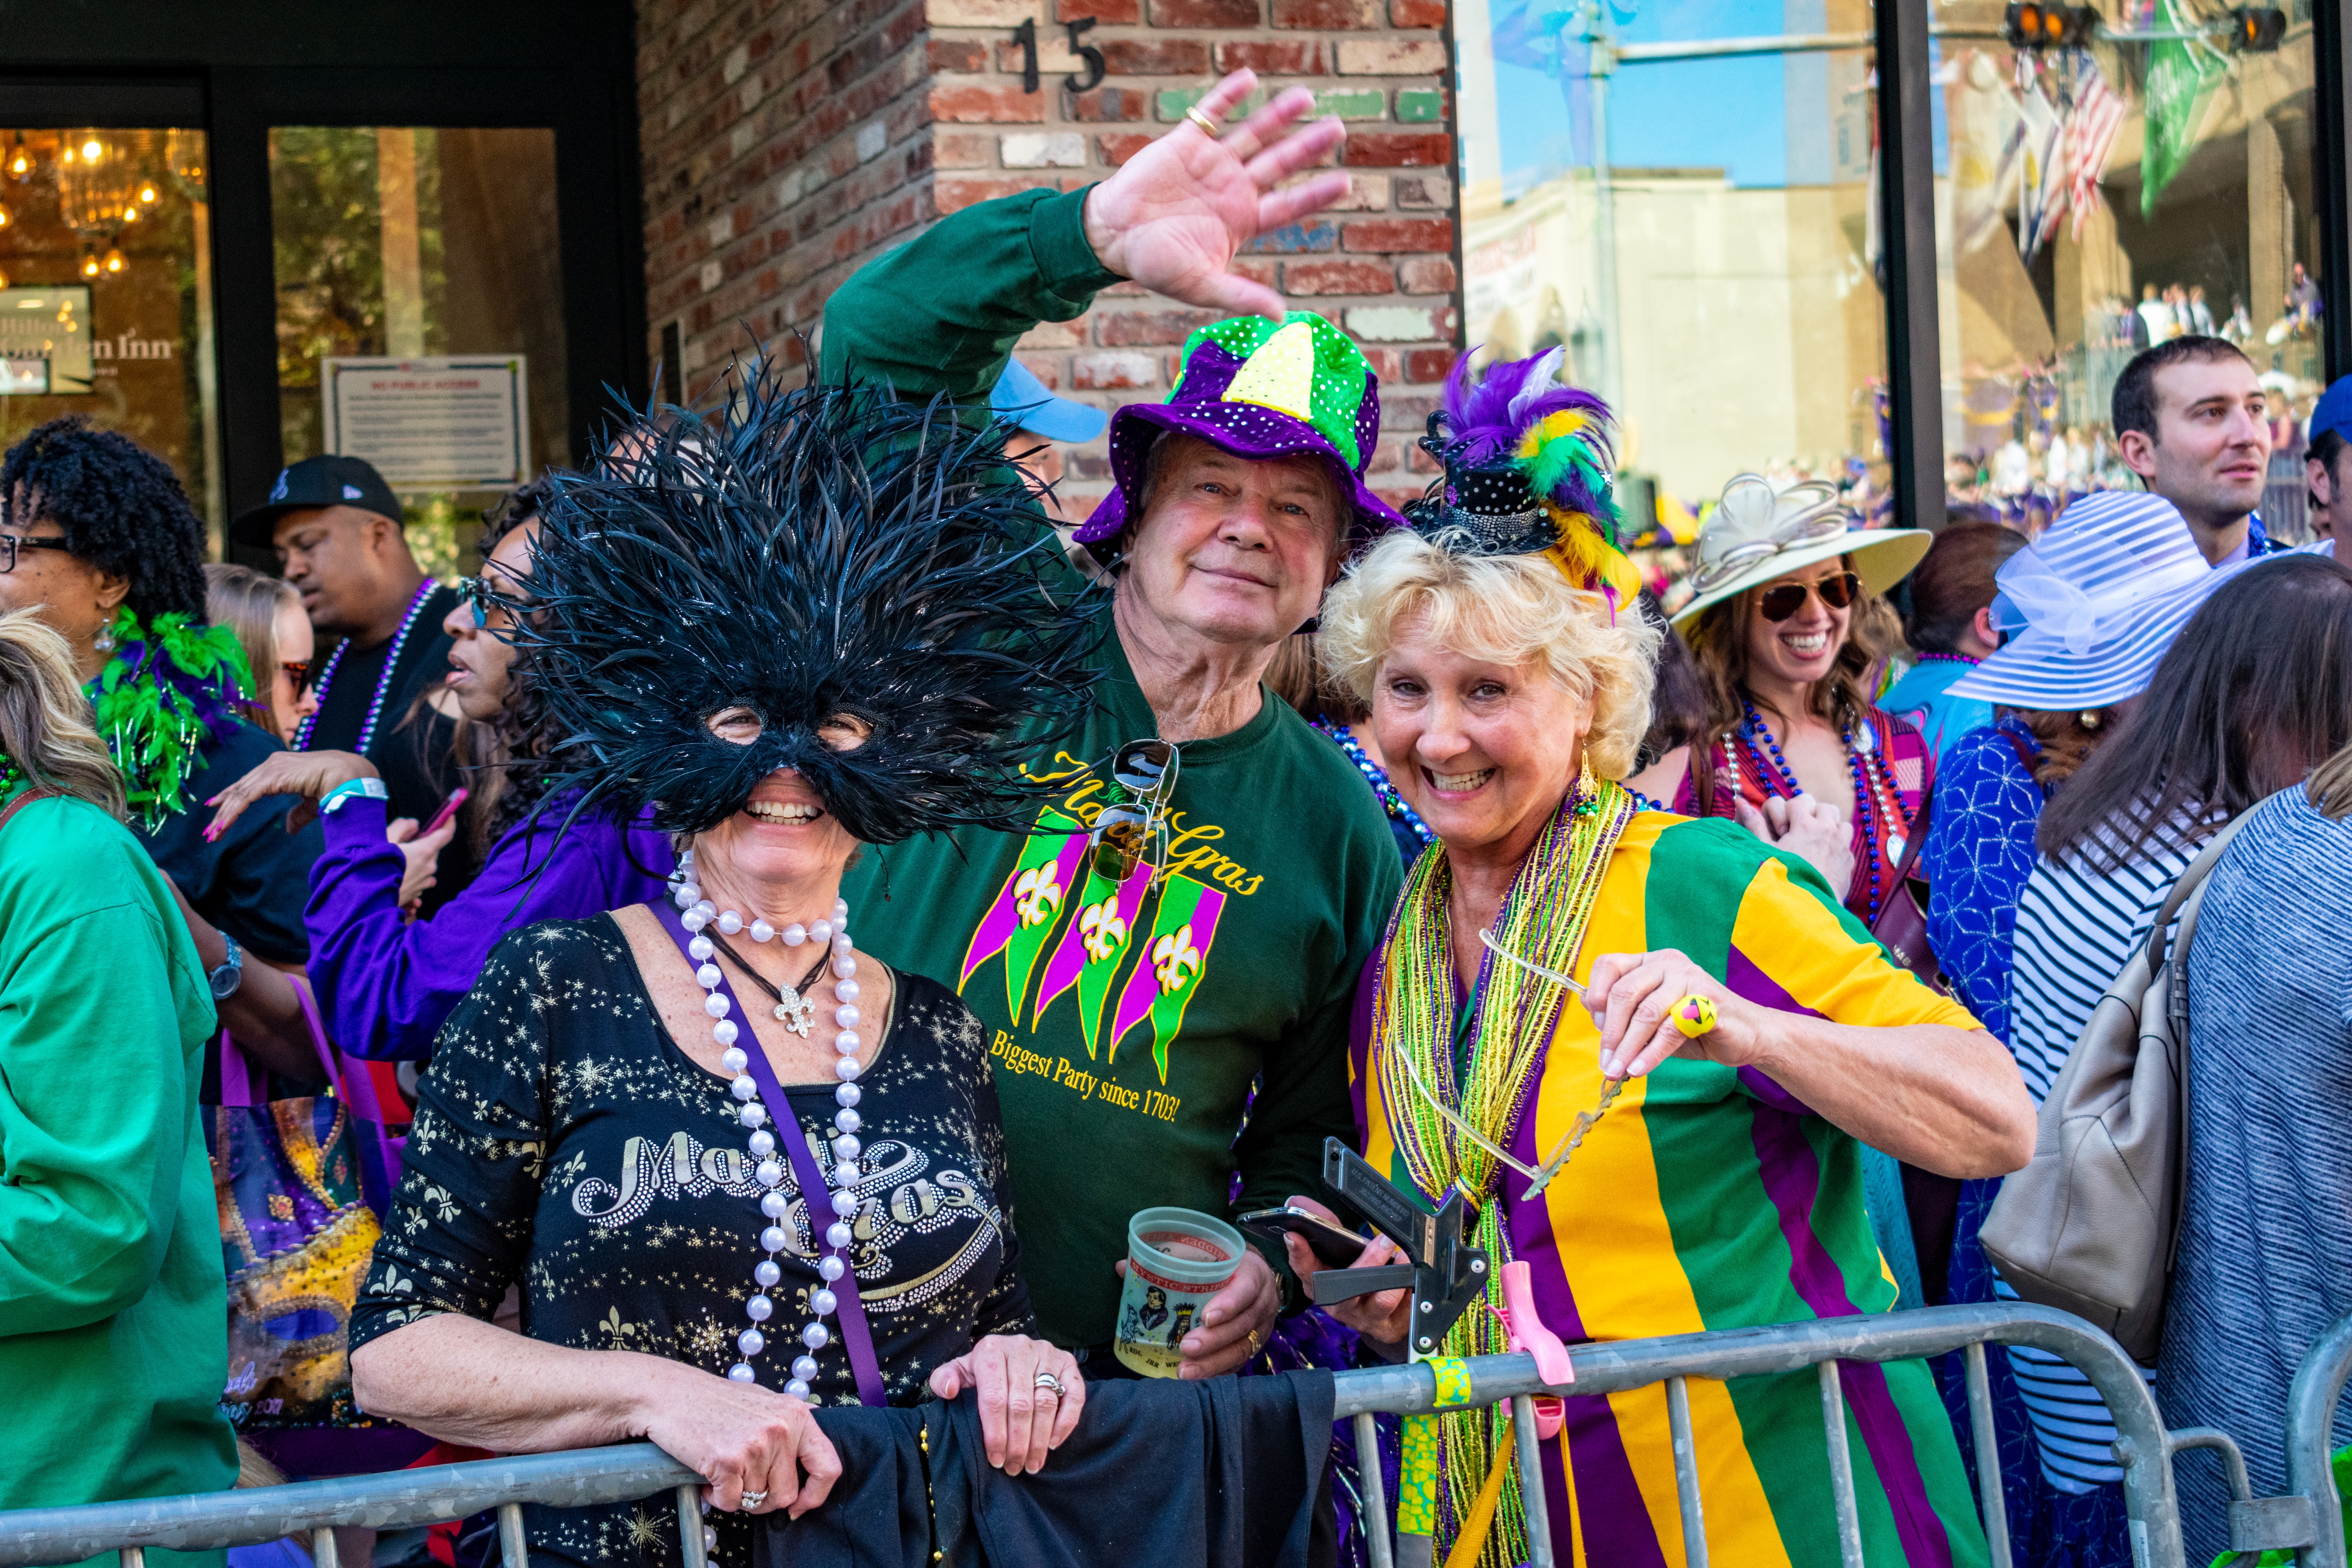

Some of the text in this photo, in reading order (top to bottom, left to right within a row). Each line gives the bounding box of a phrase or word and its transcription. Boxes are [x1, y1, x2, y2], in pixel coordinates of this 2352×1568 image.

[1012, 16, 1106, 94] 15
[118, 334, 171, 359] Inn
[1018, 751, 1264, 896] Madi Gras
[990, 1029, 1181, 1122] Biggest Party since 1703!
[1132, 1260, 1179, 1289] MYSTIC
[1129, 1345, 1142, 1357] RDL
